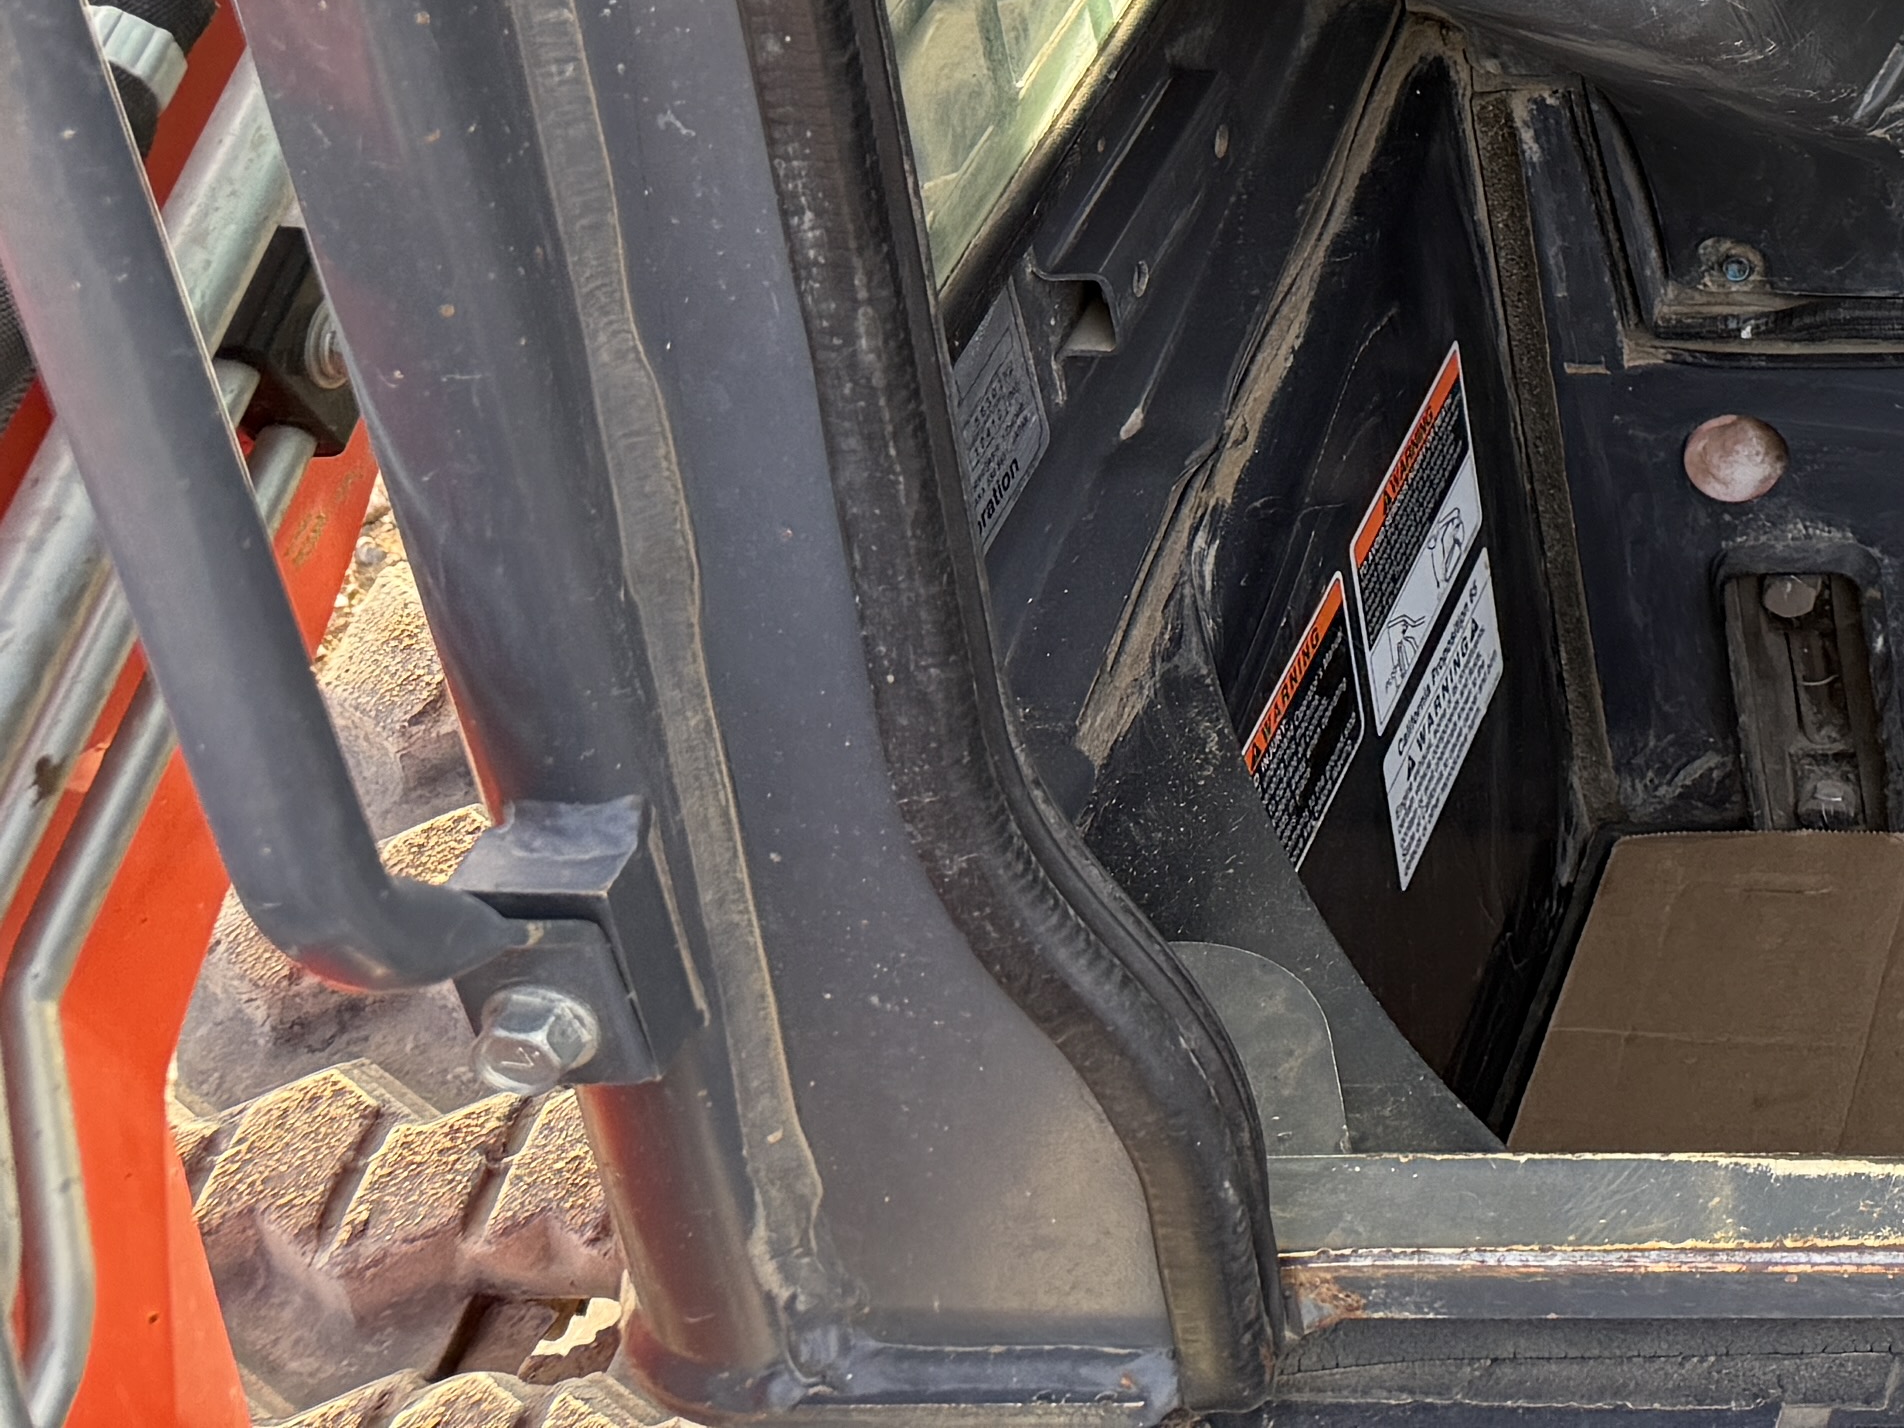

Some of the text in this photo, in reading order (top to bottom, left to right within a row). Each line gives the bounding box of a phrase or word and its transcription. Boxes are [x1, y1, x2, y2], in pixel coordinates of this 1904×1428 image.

[1389, 405, 1434, 502] WARNING
[1261, 627, 1320, 741] WARNING
[1398, 684, 1432, 756] California
[1431, 602, 1469, 686] Proposition
[1416, 636, 1469, 752] WARNING
